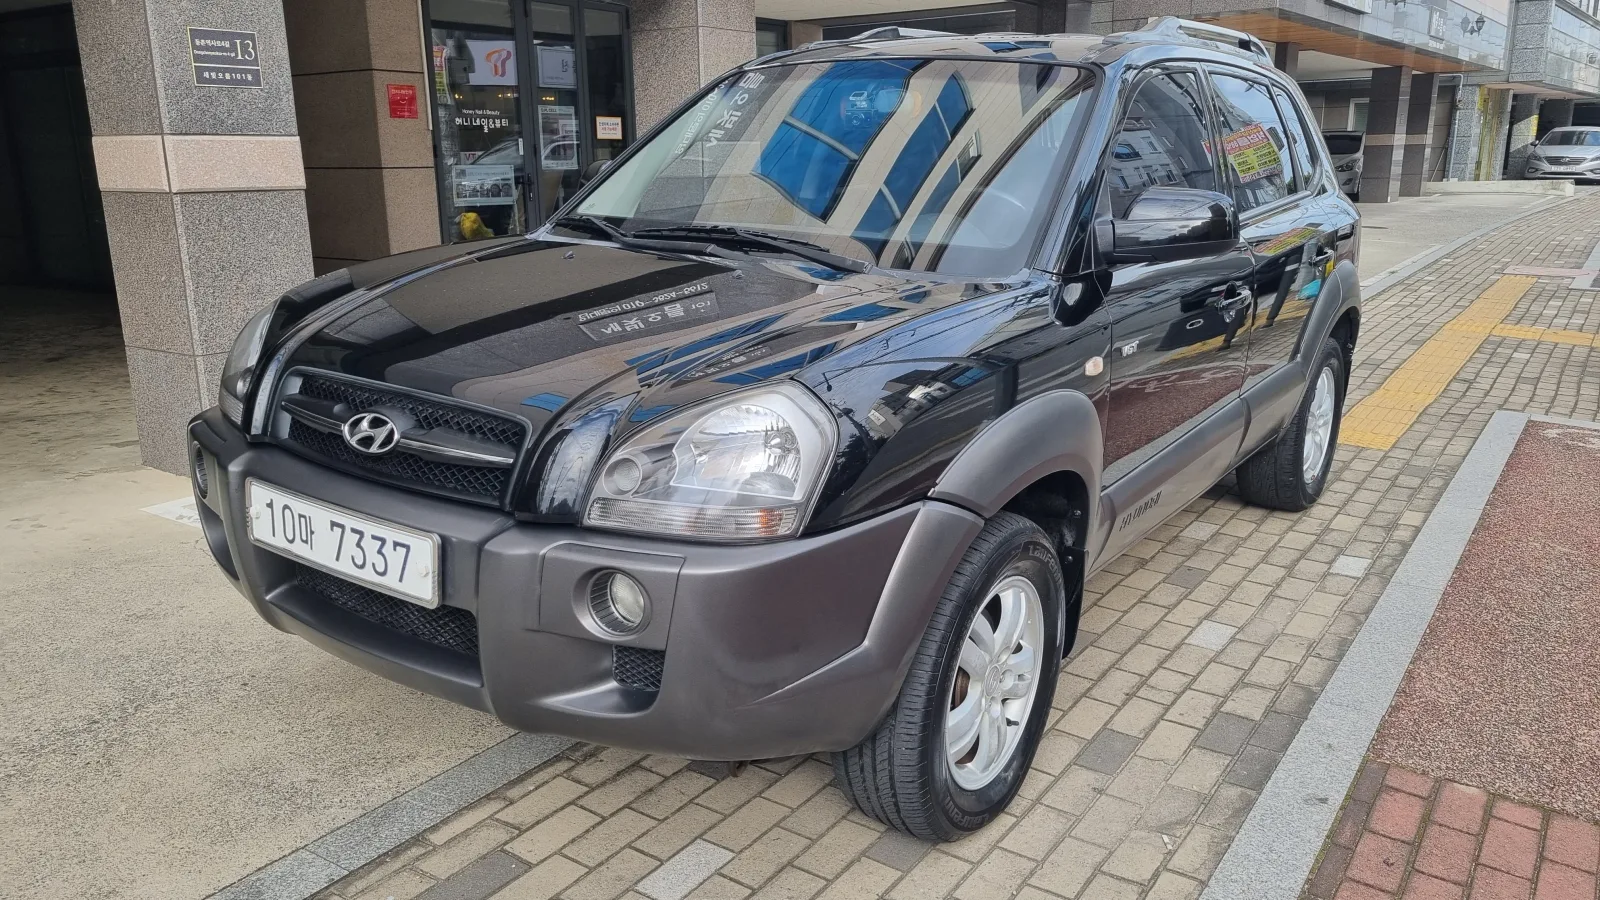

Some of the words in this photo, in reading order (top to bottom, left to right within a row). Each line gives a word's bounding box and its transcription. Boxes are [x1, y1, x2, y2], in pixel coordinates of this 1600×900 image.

[234, 39, 255, 60] 13
[455, 117, 471, 126] 허니
[265, 498, 315, 551] 10마
[329, 519, 411, 584] 7337
